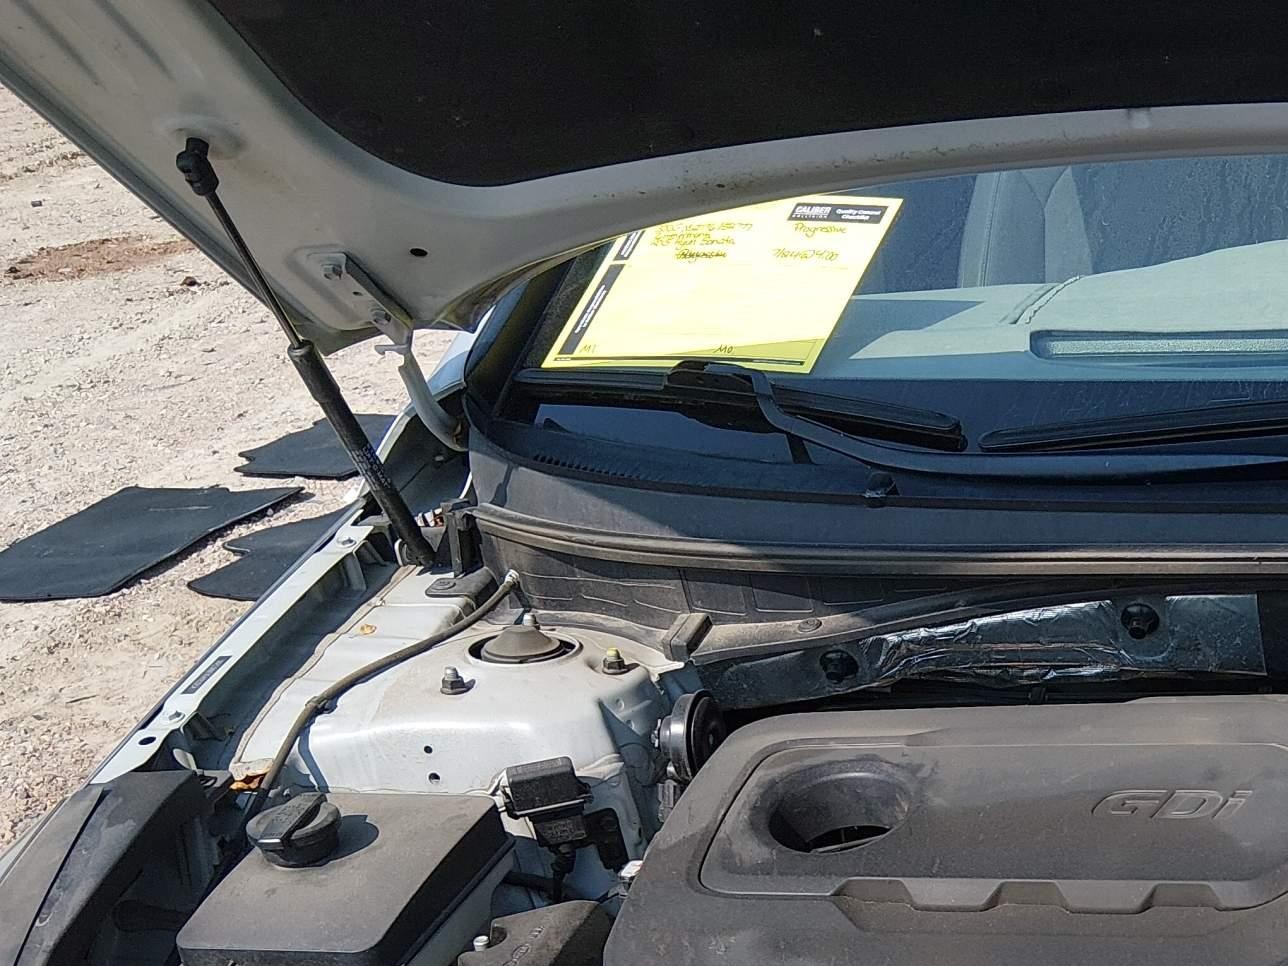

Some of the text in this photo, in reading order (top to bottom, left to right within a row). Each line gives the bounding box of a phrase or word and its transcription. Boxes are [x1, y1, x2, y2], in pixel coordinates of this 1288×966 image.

[795, 206, 832, 214] CALIBER
[794, 222, 848, 238] Progressive
[1090, 788, 1254, 820] GDi
